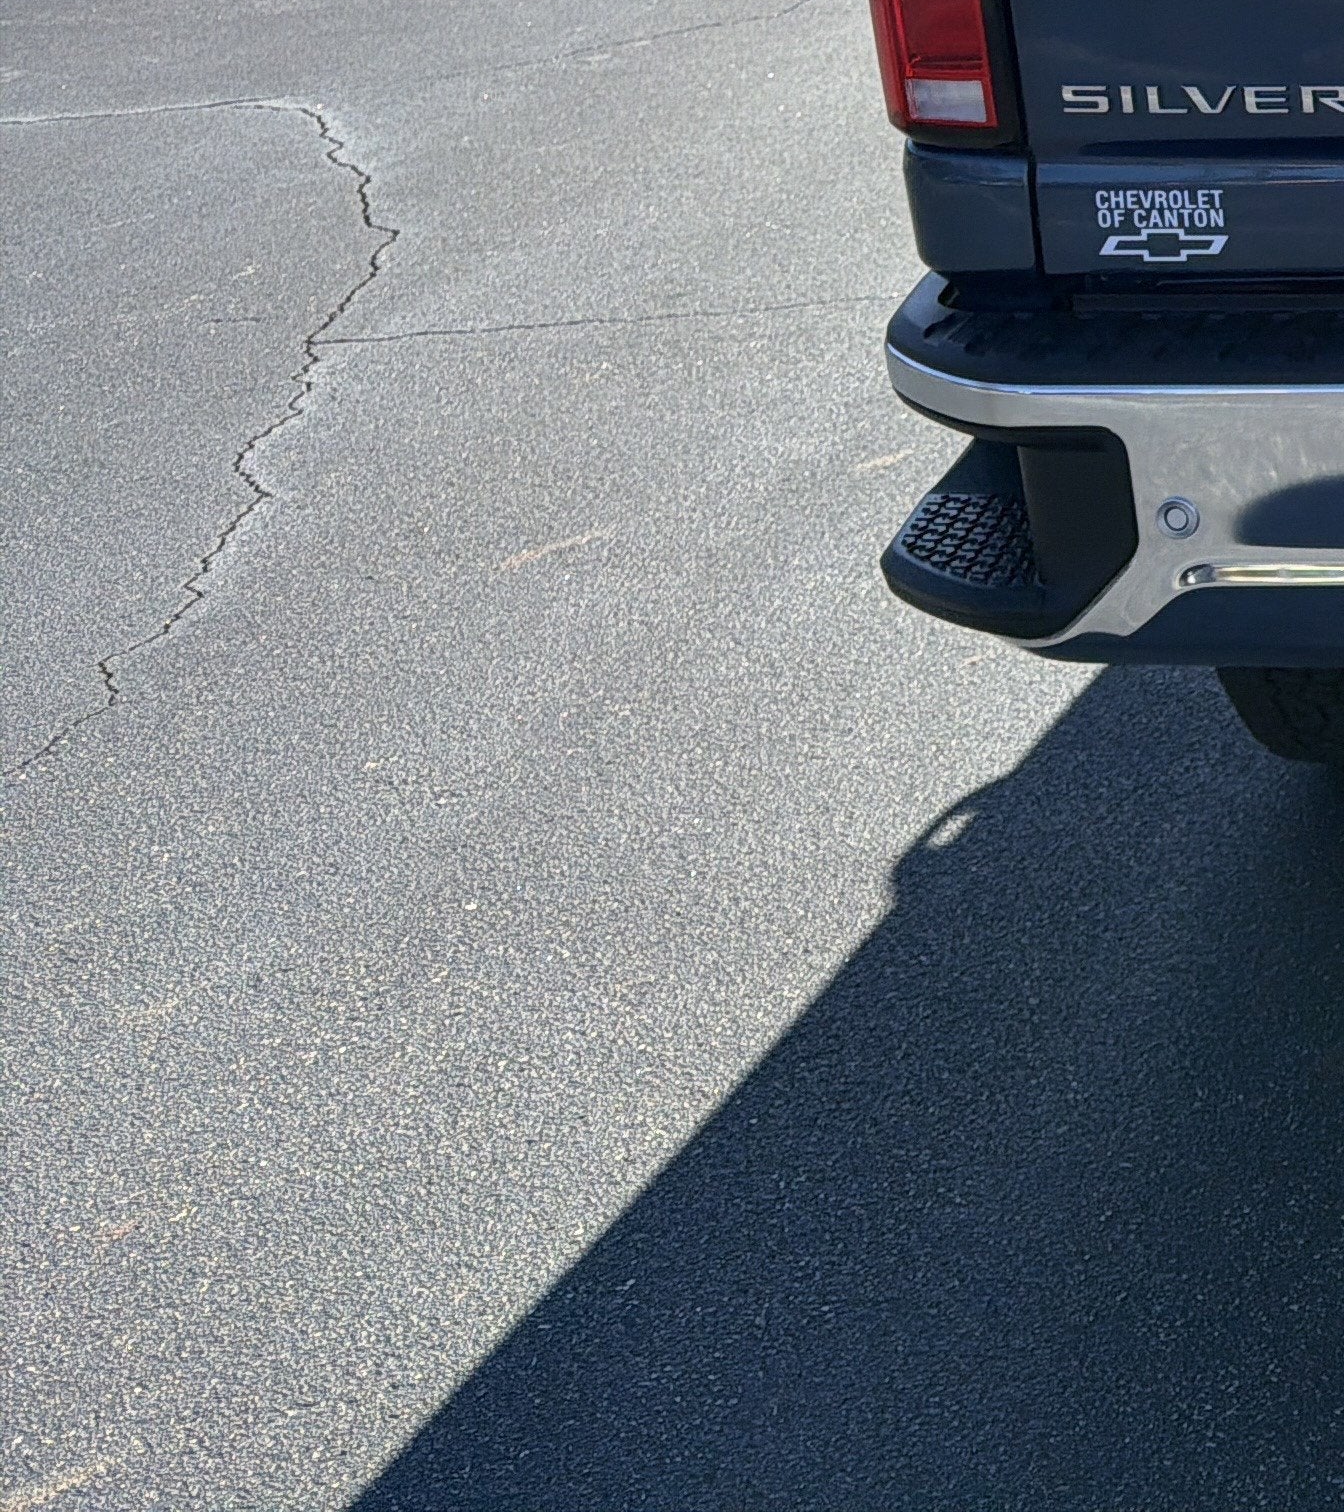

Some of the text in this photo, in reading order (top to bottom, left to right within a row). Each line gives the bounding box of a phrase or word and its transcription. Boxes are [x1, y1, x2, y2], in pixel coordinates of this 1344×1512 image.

[1095, 189, 1224, 209] CHEVROLET
[1097, 209, 1226, 228] OF CANTON
